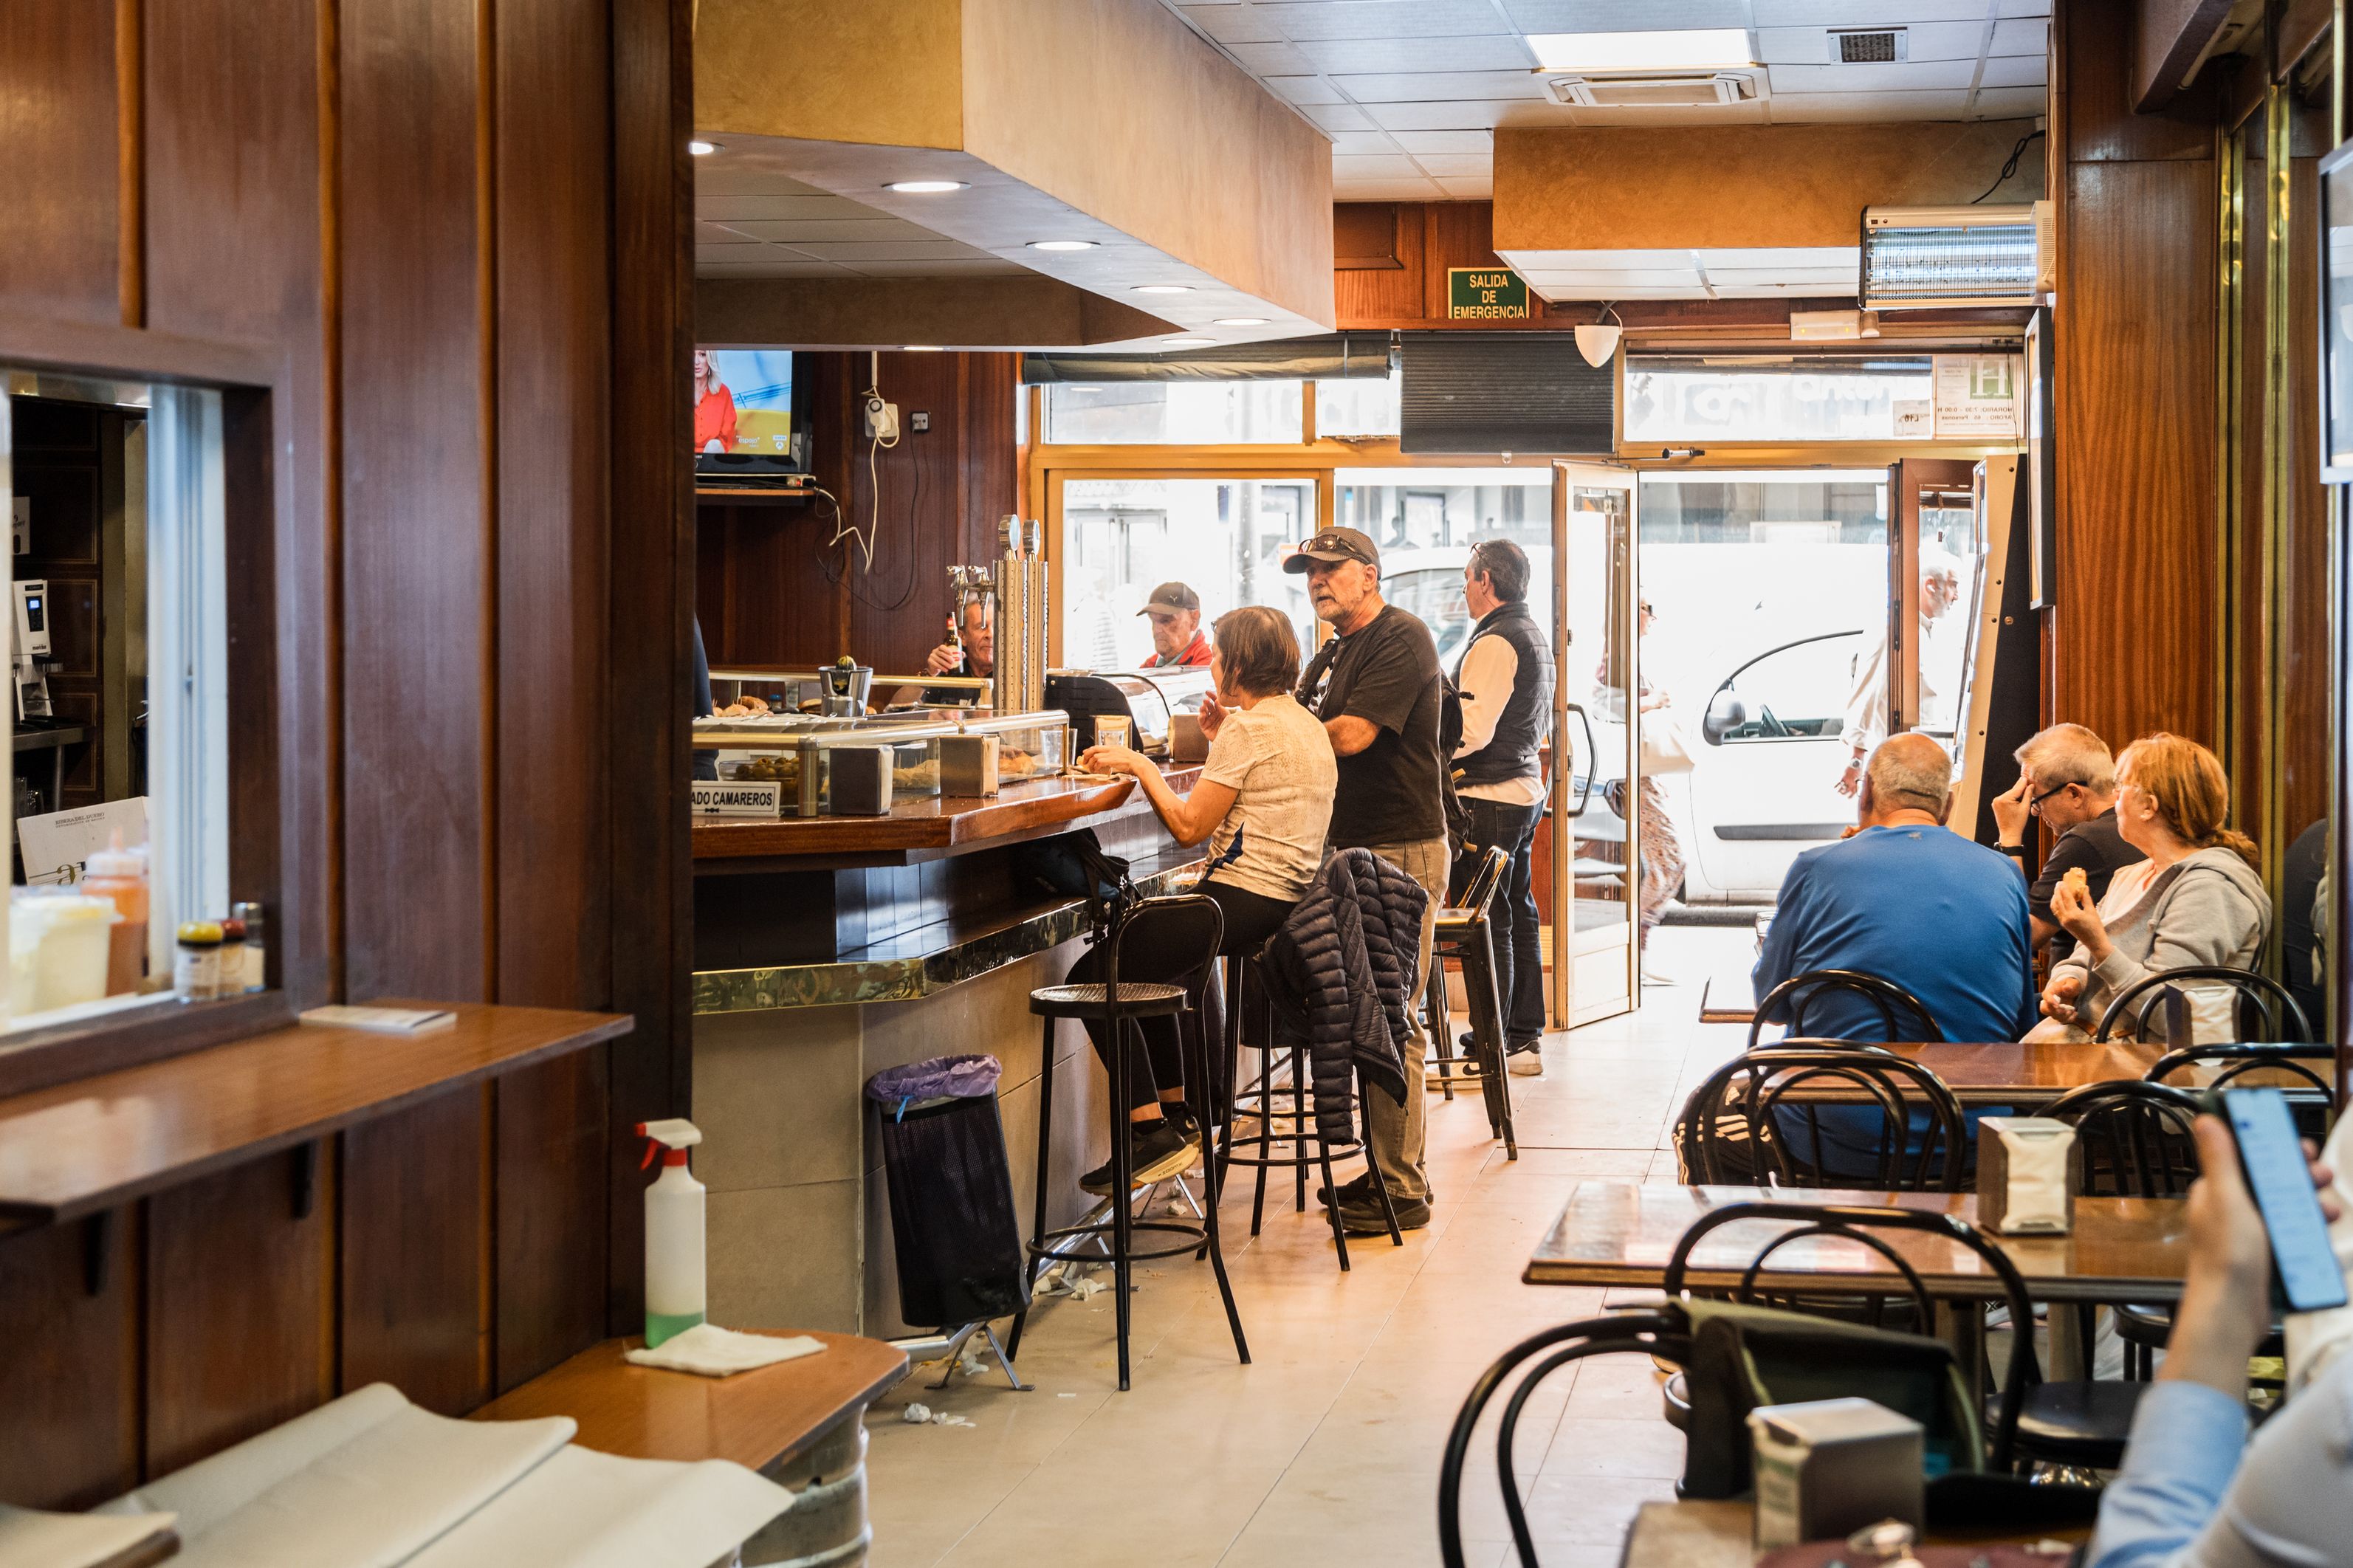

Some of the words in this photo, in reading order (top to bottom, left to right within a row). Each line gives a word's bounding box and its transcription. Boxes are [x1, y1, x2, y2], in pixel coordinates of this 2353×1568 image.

[1469, 274, 1508, 288] SALIDA
[1482, 290, 1497, 303] DE
[1454, 306, 1525, 319] EMERGENCIA
[712, 792, 773, 806] CAMAREROS
